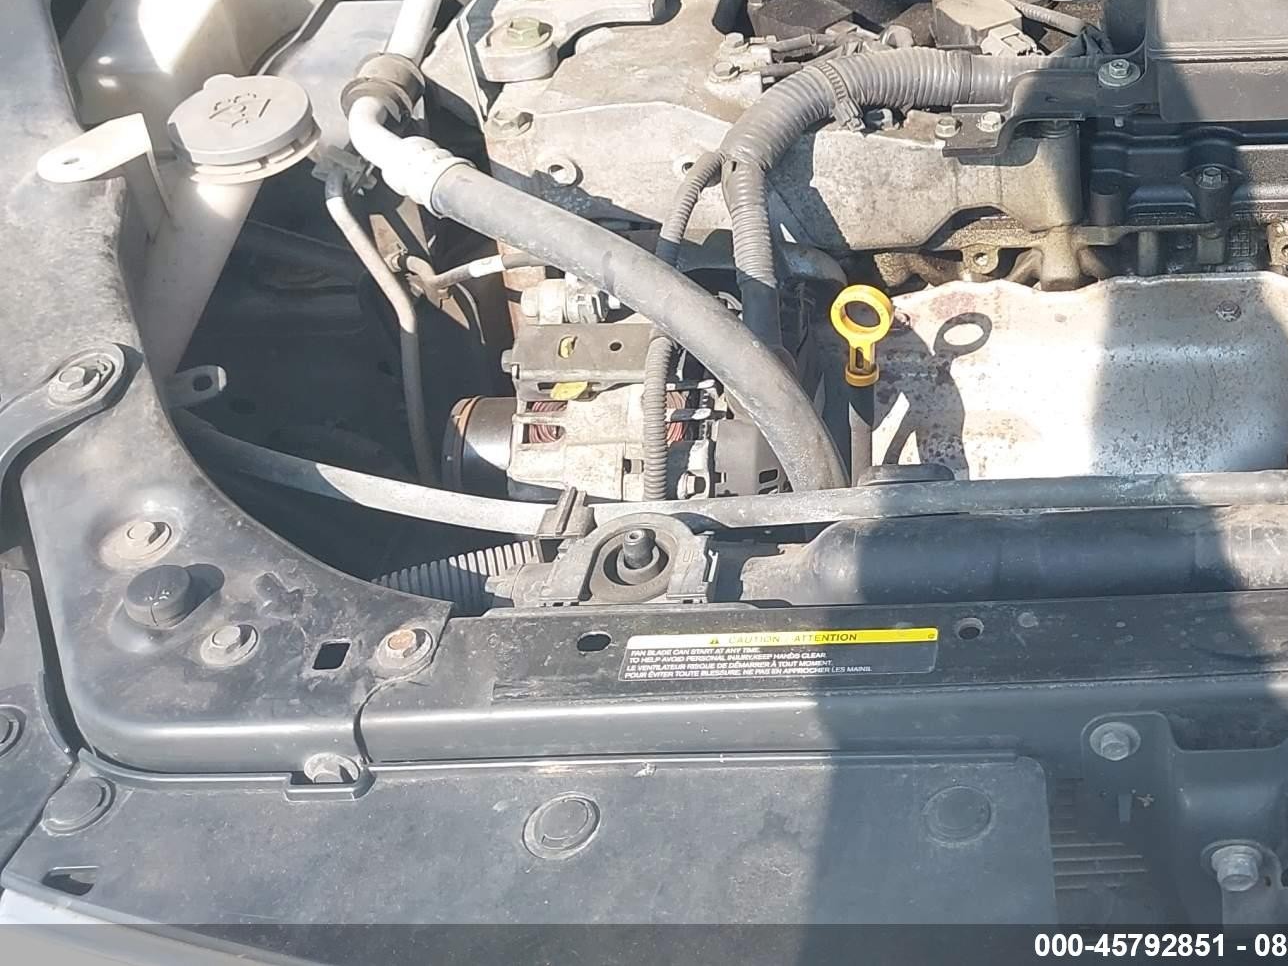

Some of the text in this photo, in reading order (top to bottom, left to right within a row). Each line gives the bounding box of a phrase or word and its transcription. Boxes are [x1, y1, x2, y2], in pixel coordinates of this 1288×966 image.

[728, 633, 857, 644] CAUTION ATTENTION
[672, 648, 690, 656] CAN
[774, 652, 800, 660] HANDS
